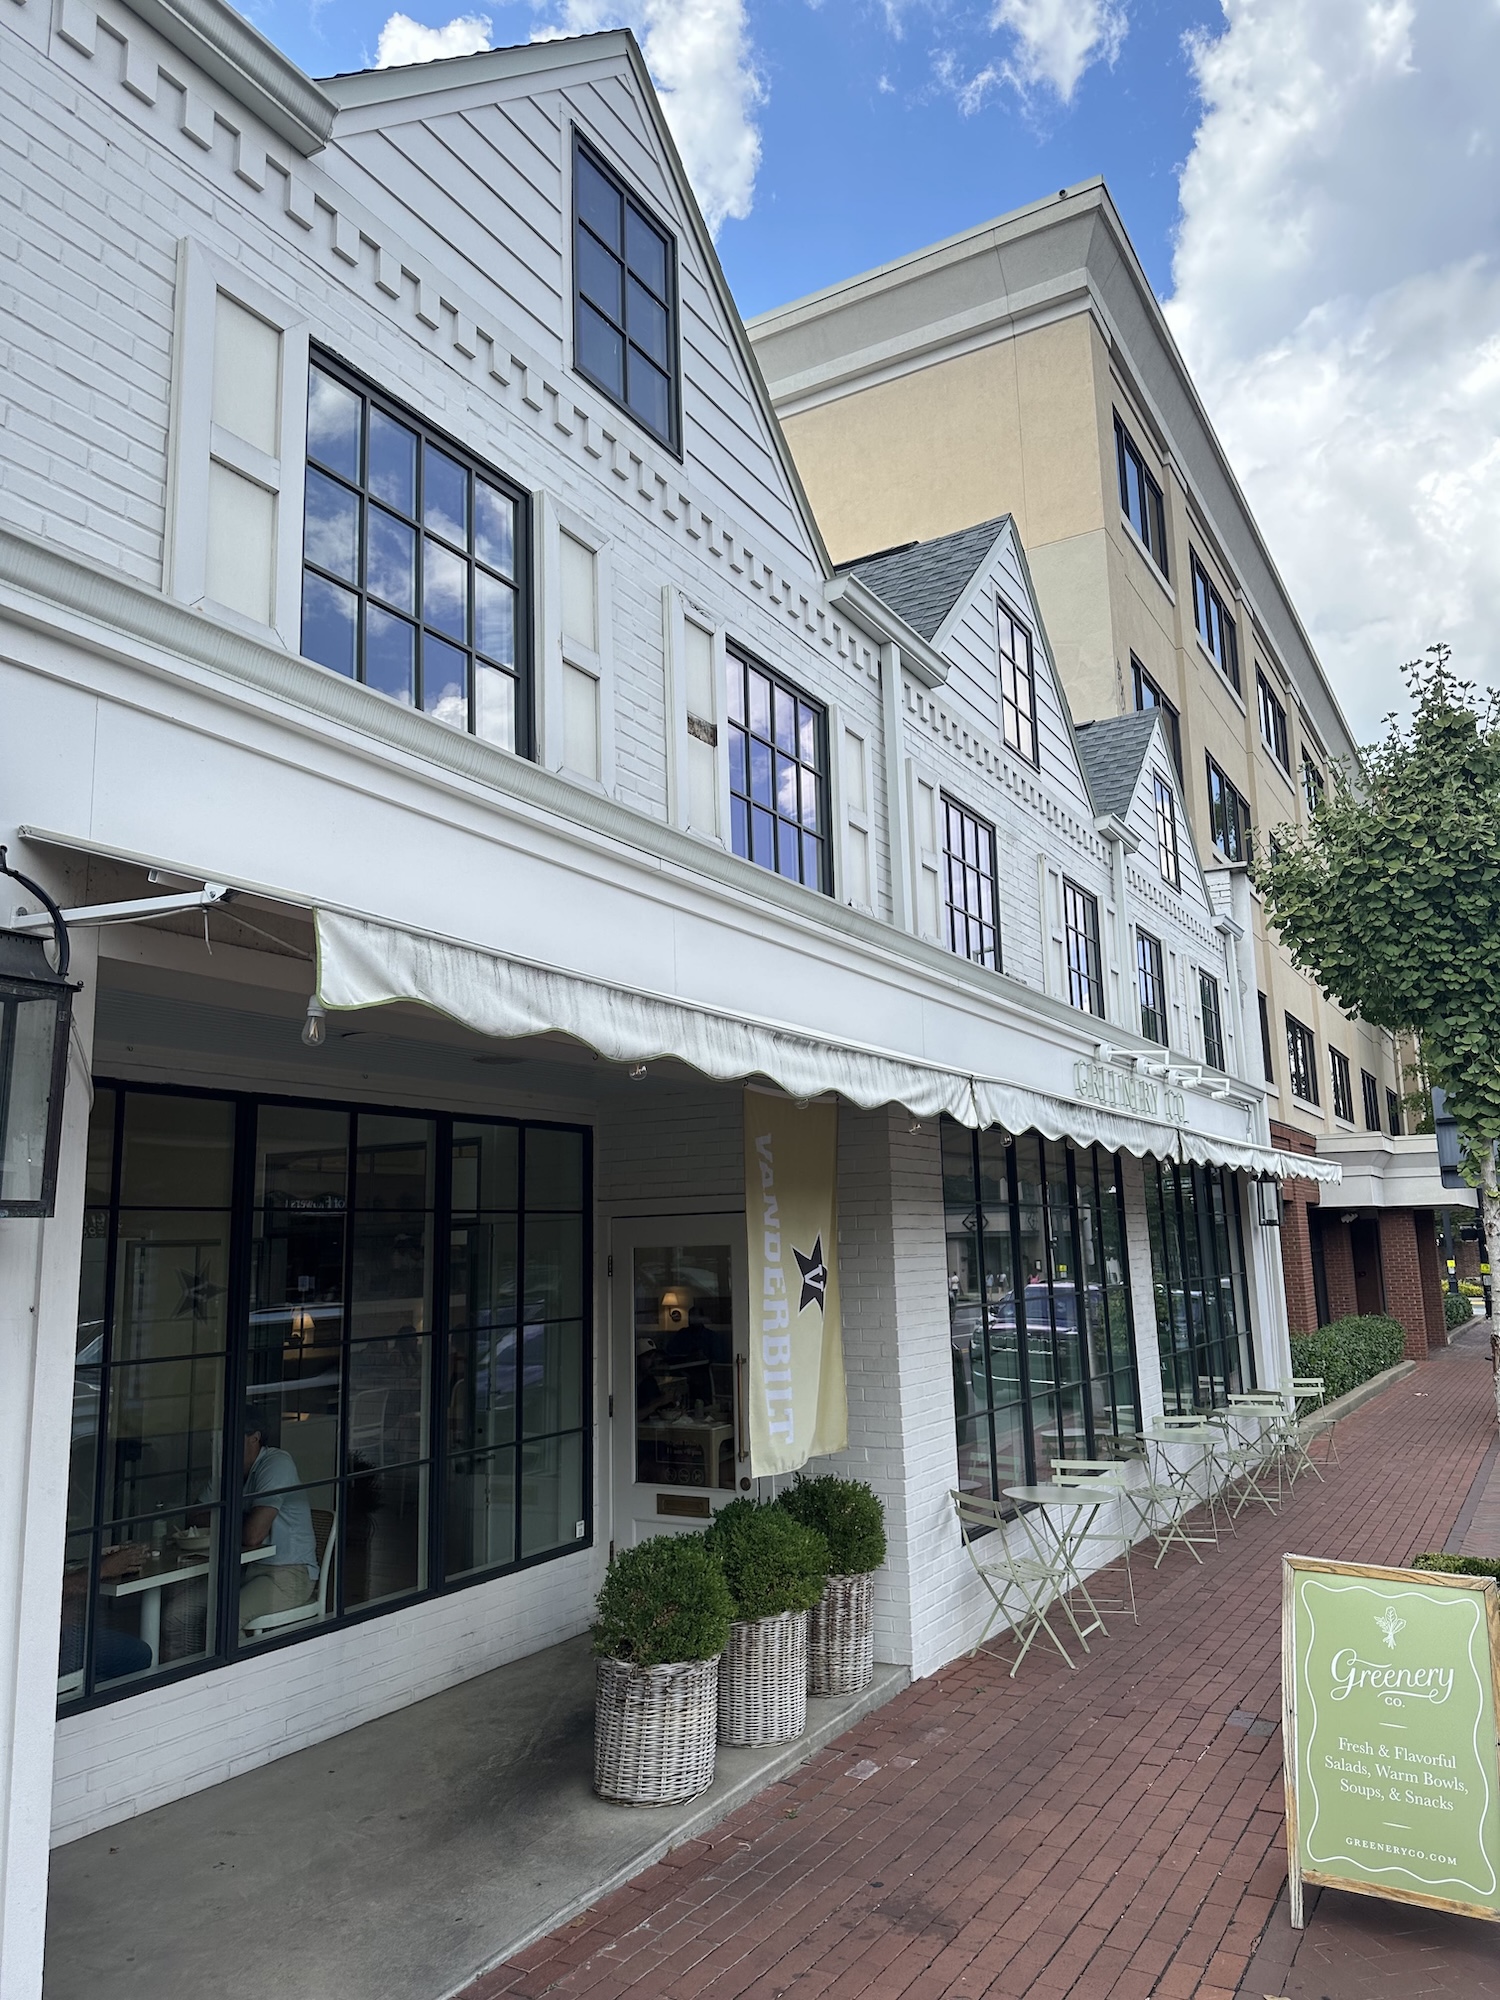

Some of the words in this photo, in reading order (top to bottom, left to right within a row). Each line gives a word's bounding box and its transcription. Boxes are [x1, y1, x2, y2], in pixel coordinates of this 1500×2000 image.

[1073, 1058, 1158, 1116] GREENERY
[754, 1132, 794, 1445] VANDERBILT
[1329, 1647, 1455, 1705] Greenery
[1338, 1736, 1375, 1756] Fresh
[1378, 1744, 1391, 1758] &
[1394, 1746, 1456, 1769] Flavorful
[1324, 1755, 1371, 1778] Salads,
[1375, 1763, 1419, 1783] Warm
[1423, 1771, 1469, 1795] Bowls,
[1340, 1778, 1385, 1800] Soups,
[1390, 1787, 1402, 1802] &
[1405, 1792, 1454, 1812] Snacks
[1345, 1836, 1458, 1866] GREENERYCO.COM
